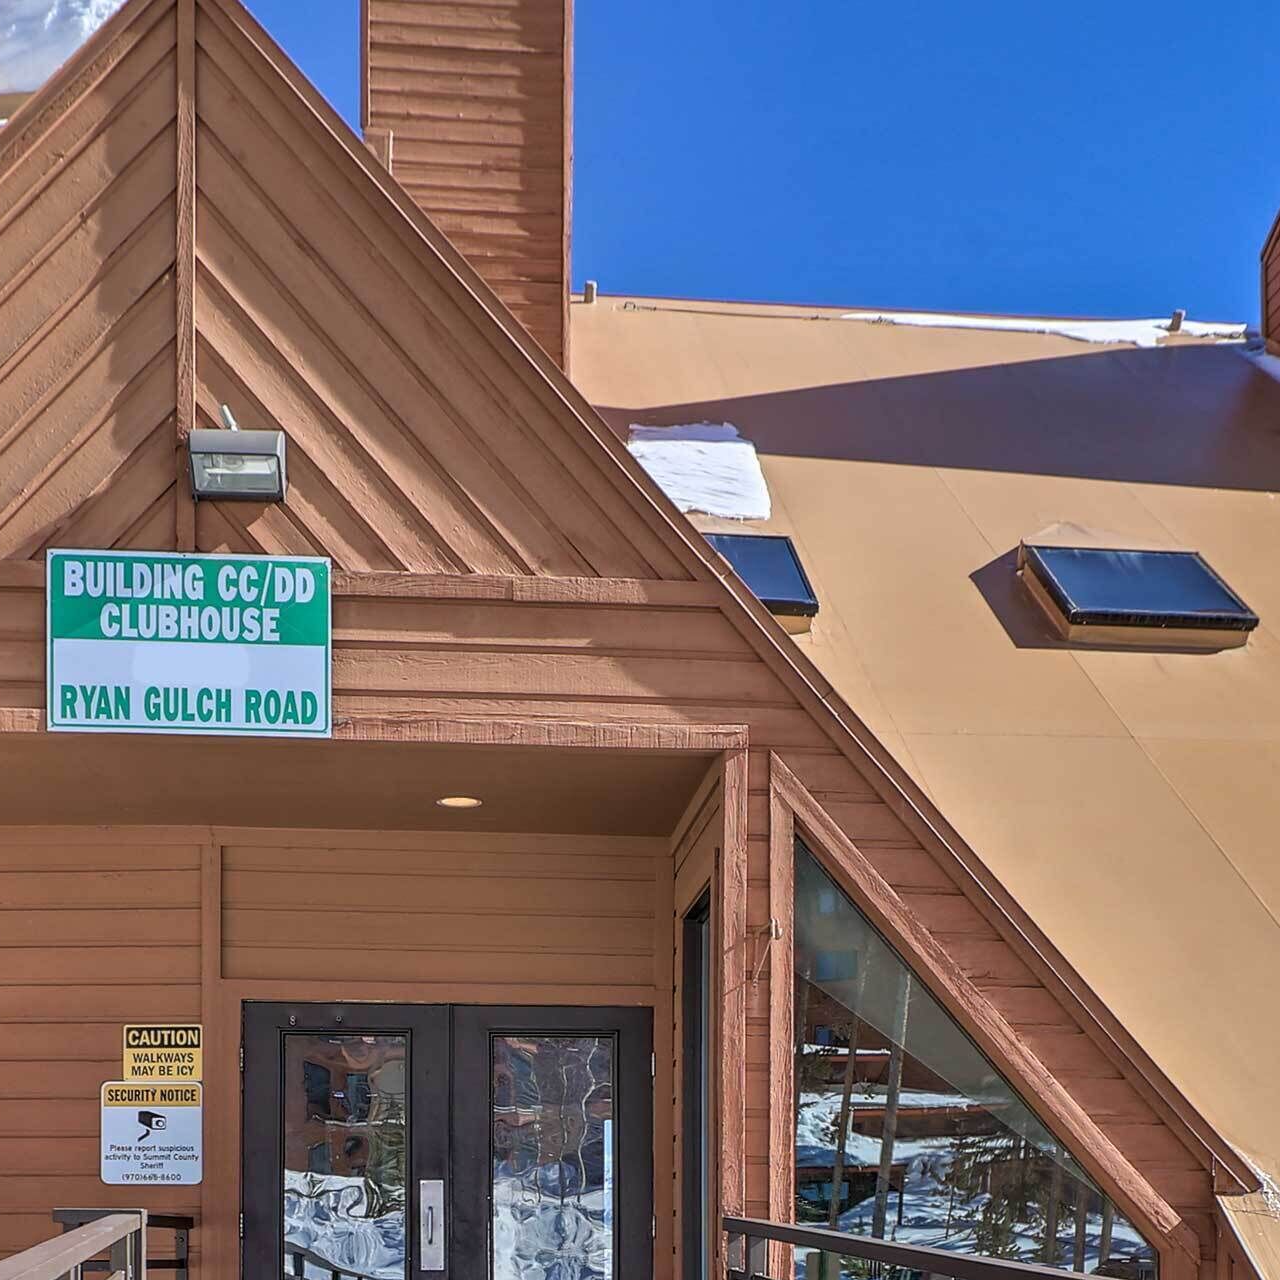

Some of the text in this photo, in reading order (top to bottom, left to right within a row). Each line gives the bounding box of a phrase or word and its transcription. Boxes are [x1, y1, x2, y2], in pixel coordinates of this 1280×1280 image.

[63, 560, 316, 606] BUILDING CC/DD
[99, 602, 281, 642] CLUBHOUSE
[60, 684, 318, 725] RYAN GULCH ROAD
[128, 1030, 198, 1046] CAUTION
[132, 1052, 194, 1063] WALKWAYS
[131, 1065, 194, 1076] MAY BE ICY
[107, 1088, 197, 1102] SECURITY NOTICE
[109, 1144, 194, 1154] Please report suspicious
[104, 1153, 199, 1163] activity to Summit County
[140, 1162, 163, 1170] Sheriff
